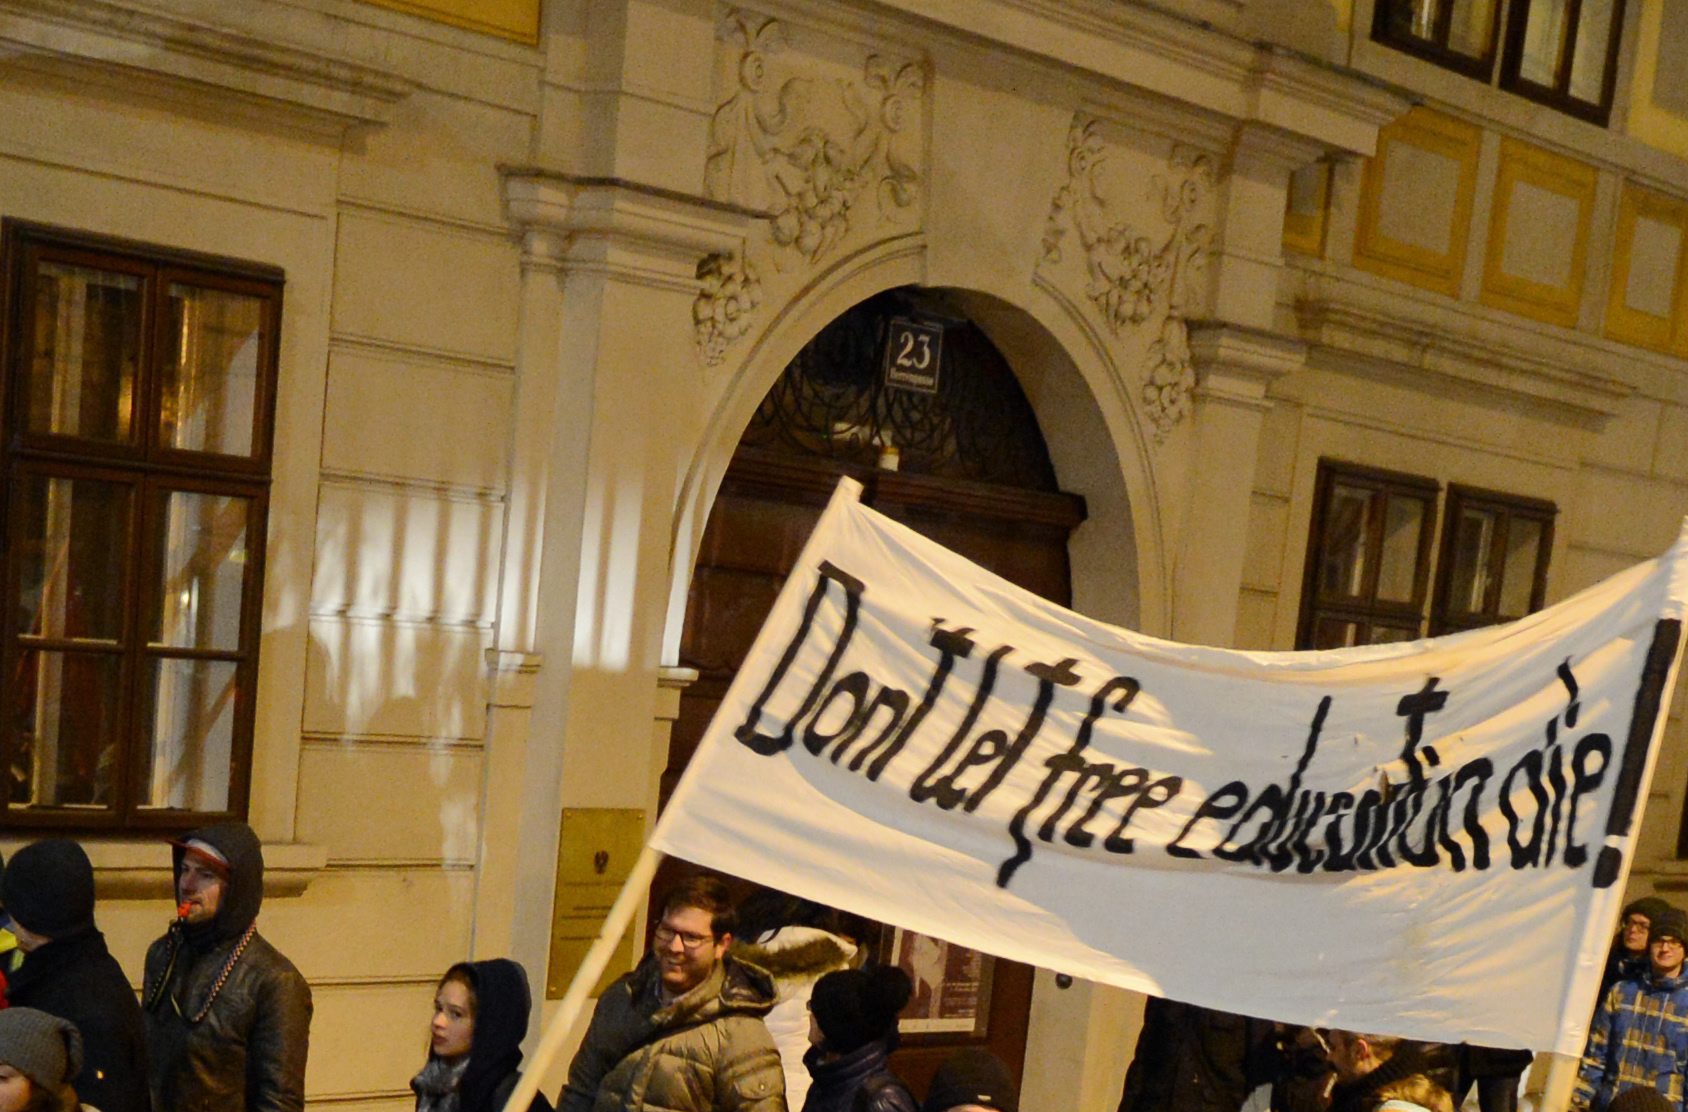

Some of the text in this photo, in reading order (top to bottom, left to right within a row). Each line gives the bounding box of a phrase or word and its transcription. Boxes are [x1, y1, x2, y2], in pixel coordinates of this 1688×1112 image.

[909, 645, 1080, 813] let
[997, 676, 1182, 888] free
[1499, 618, 1682, 888] die!
